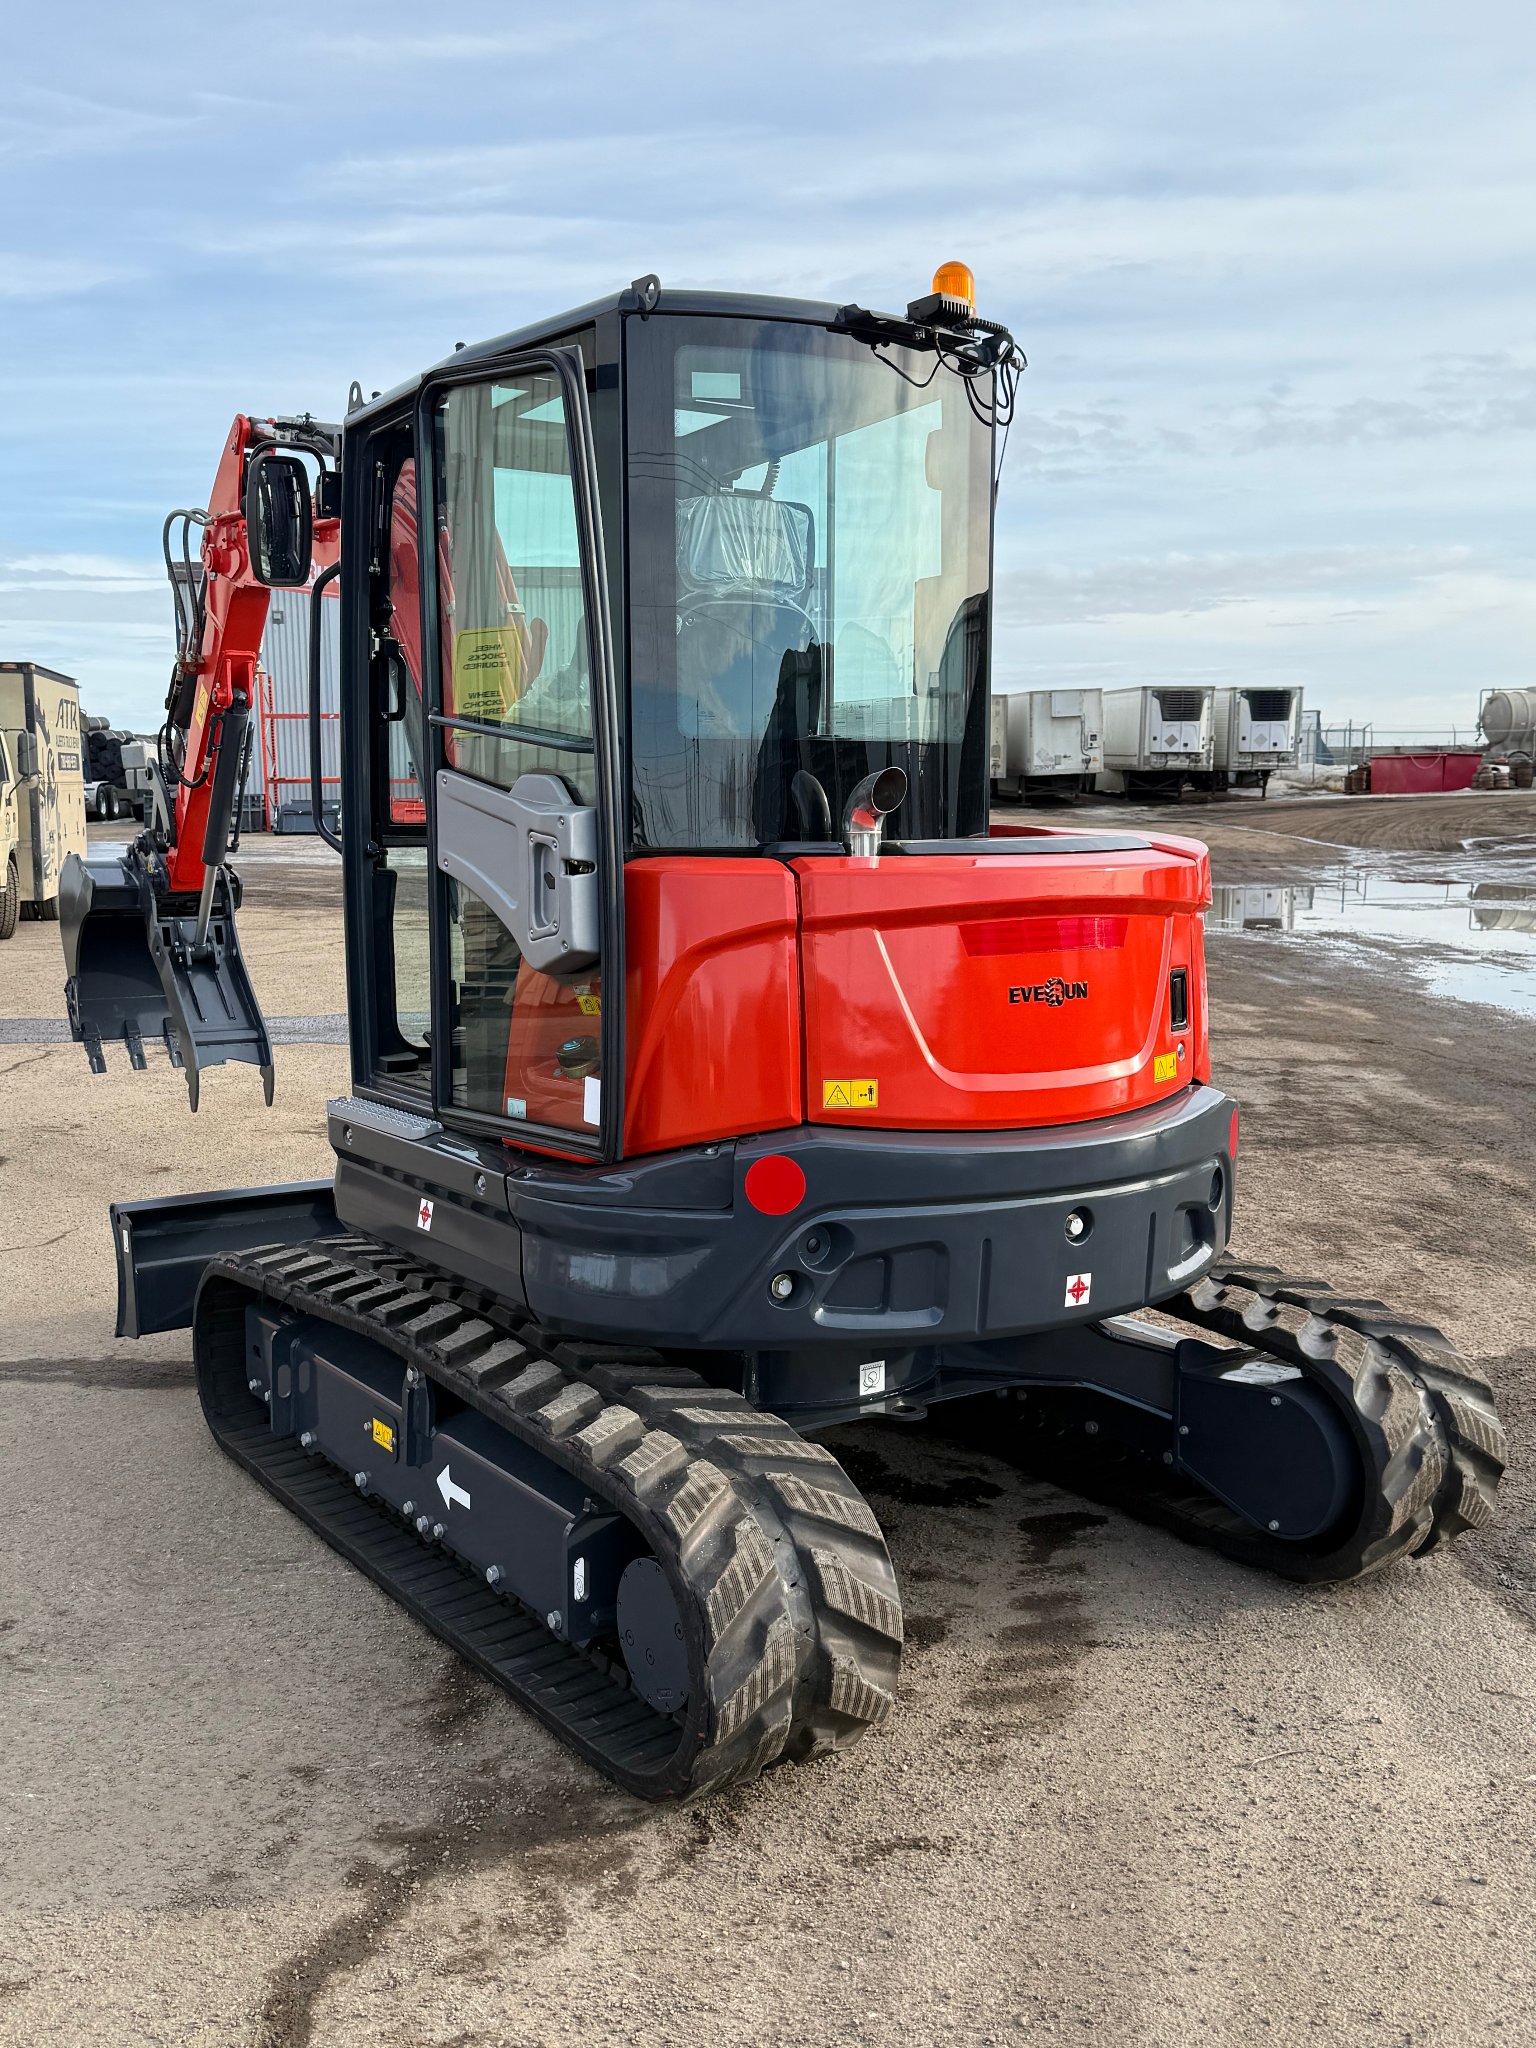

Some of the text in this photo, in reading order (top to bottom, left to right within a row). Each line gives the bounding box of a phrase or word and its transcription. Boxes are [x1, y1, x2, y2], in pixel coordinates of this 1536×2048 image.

[468, 690, 502, 699] WHEEL
[463, 698, 505, 709] CHOCKS
[56, 698, 78, 731] ATR
